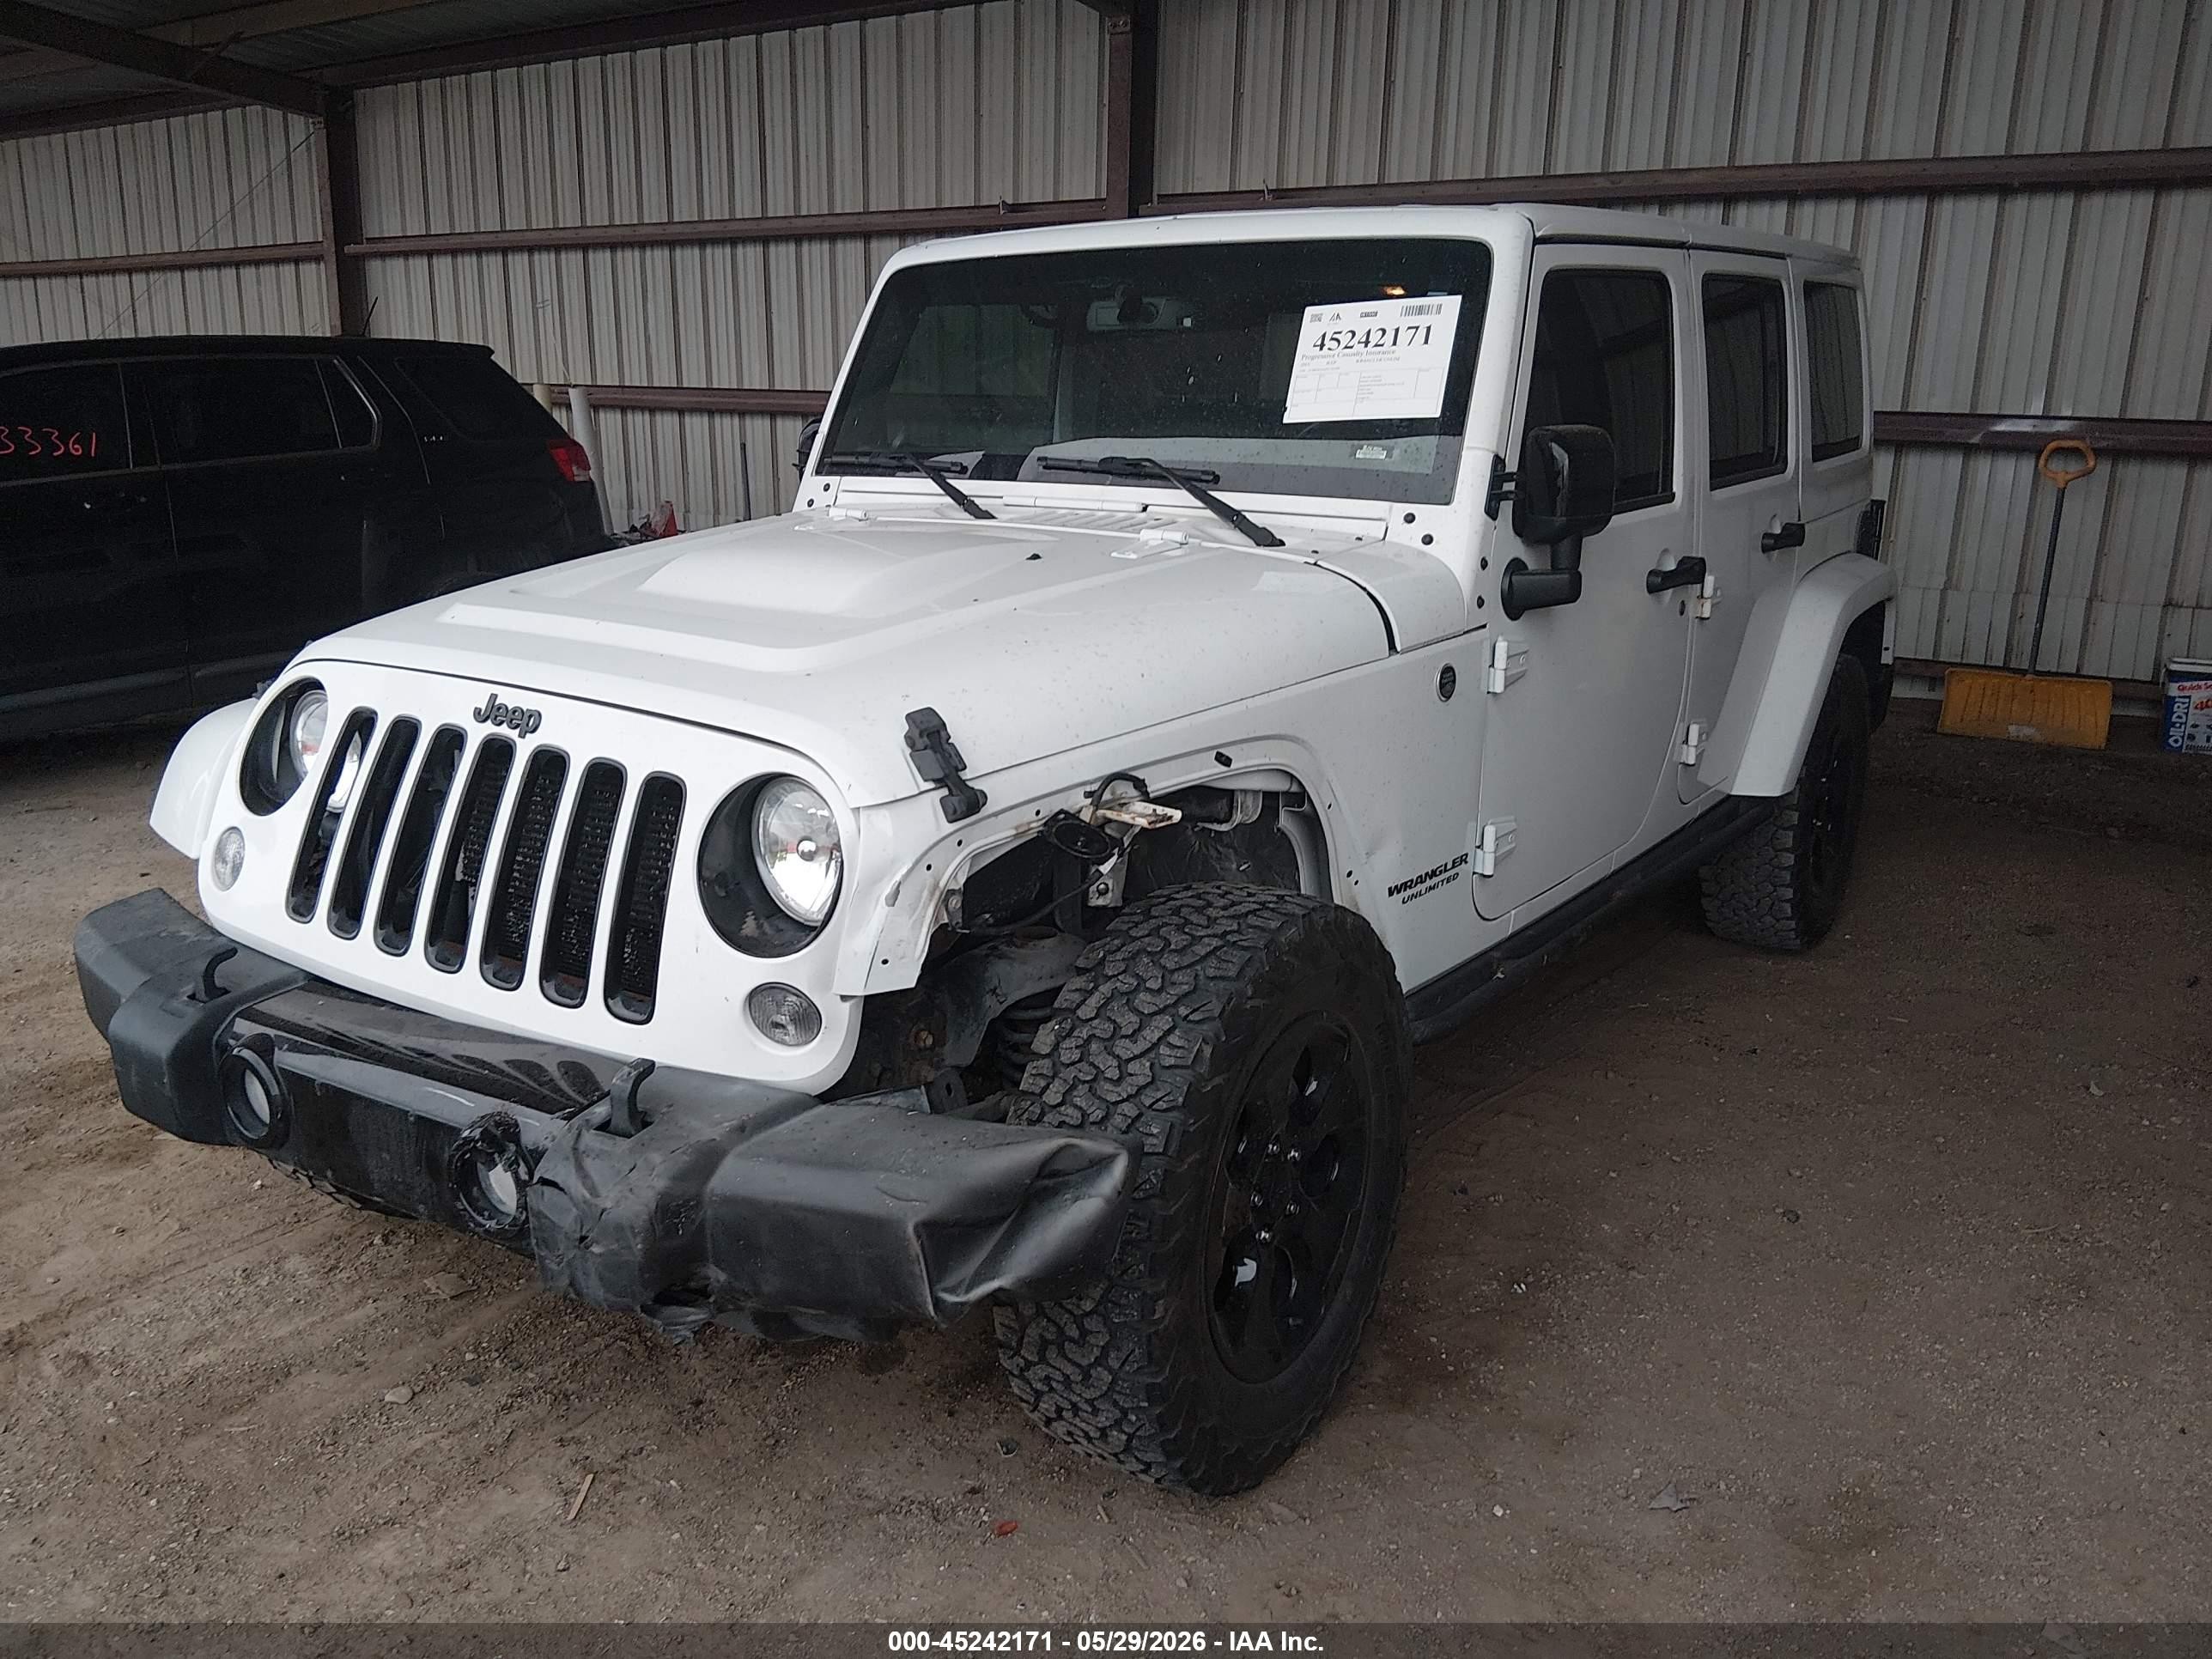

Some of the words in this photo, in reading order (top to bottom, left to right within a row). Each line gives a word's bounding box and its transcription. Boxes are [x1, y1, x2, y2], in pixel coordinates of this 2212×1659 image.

[1313, 324, 1432, 351] 45242171
[1301, 352, 1335, 362] Progressive
[473, 692, 542, 739] Jeep
[1388, 853, 1468, 897] WRANGLER
[1401, 872, 1460, 904] UNLIMITED
